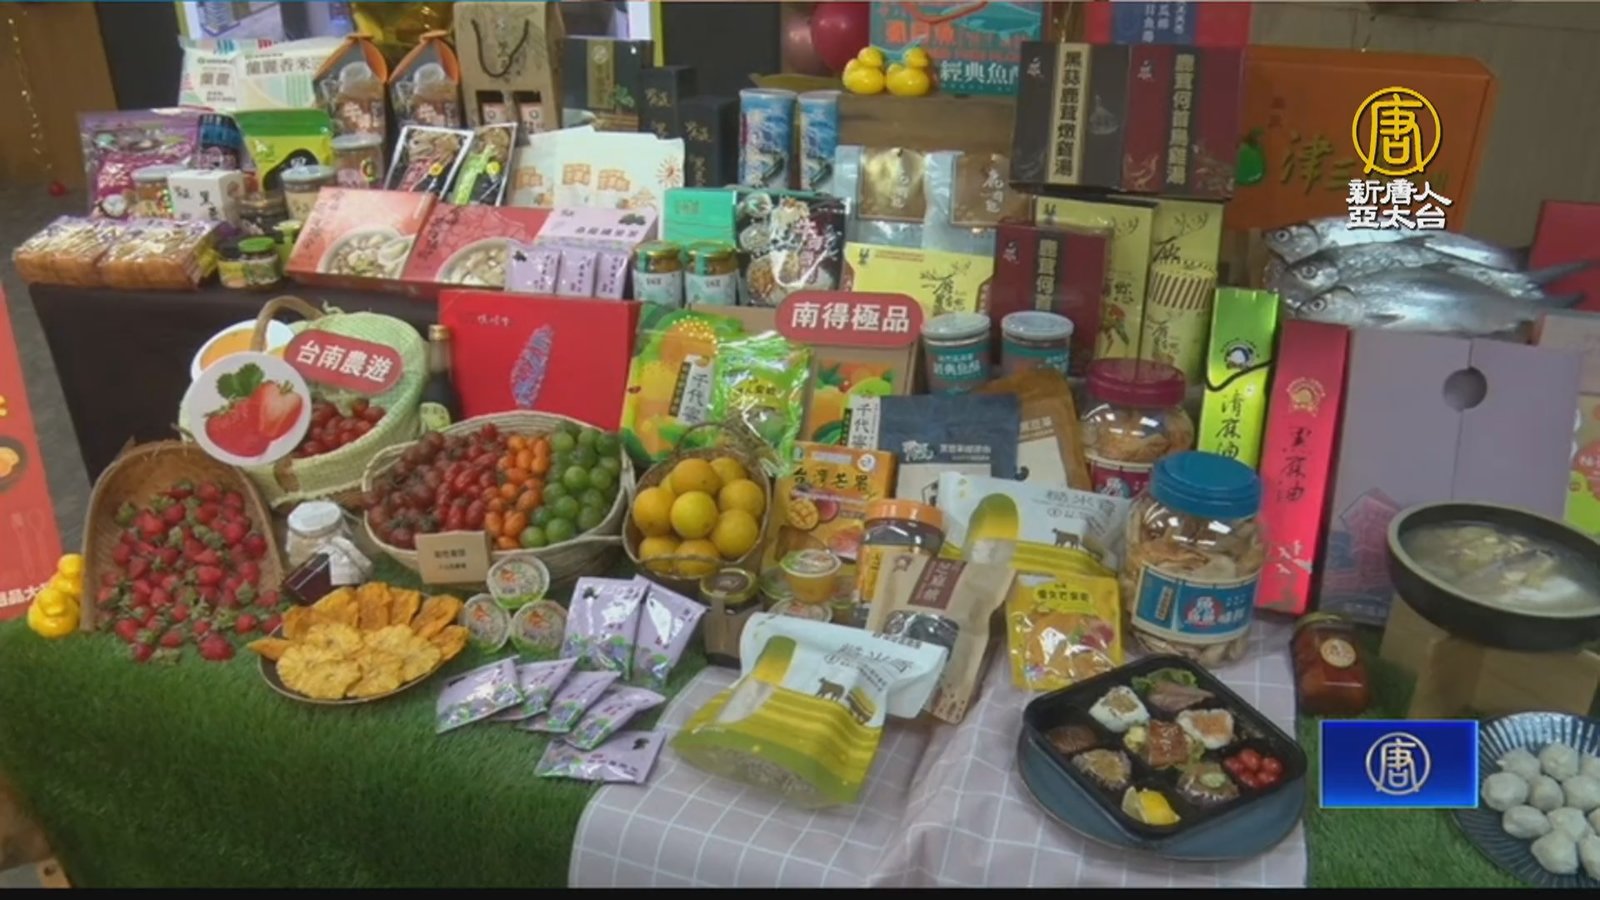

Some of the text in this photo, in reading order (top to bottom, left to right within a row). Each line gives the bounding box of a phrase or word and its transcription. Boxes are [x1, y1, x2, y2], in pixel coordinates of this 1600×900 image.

[791, 301, 911, 333] 南得極品
[296, 339, 394, 383] 台南農遊
